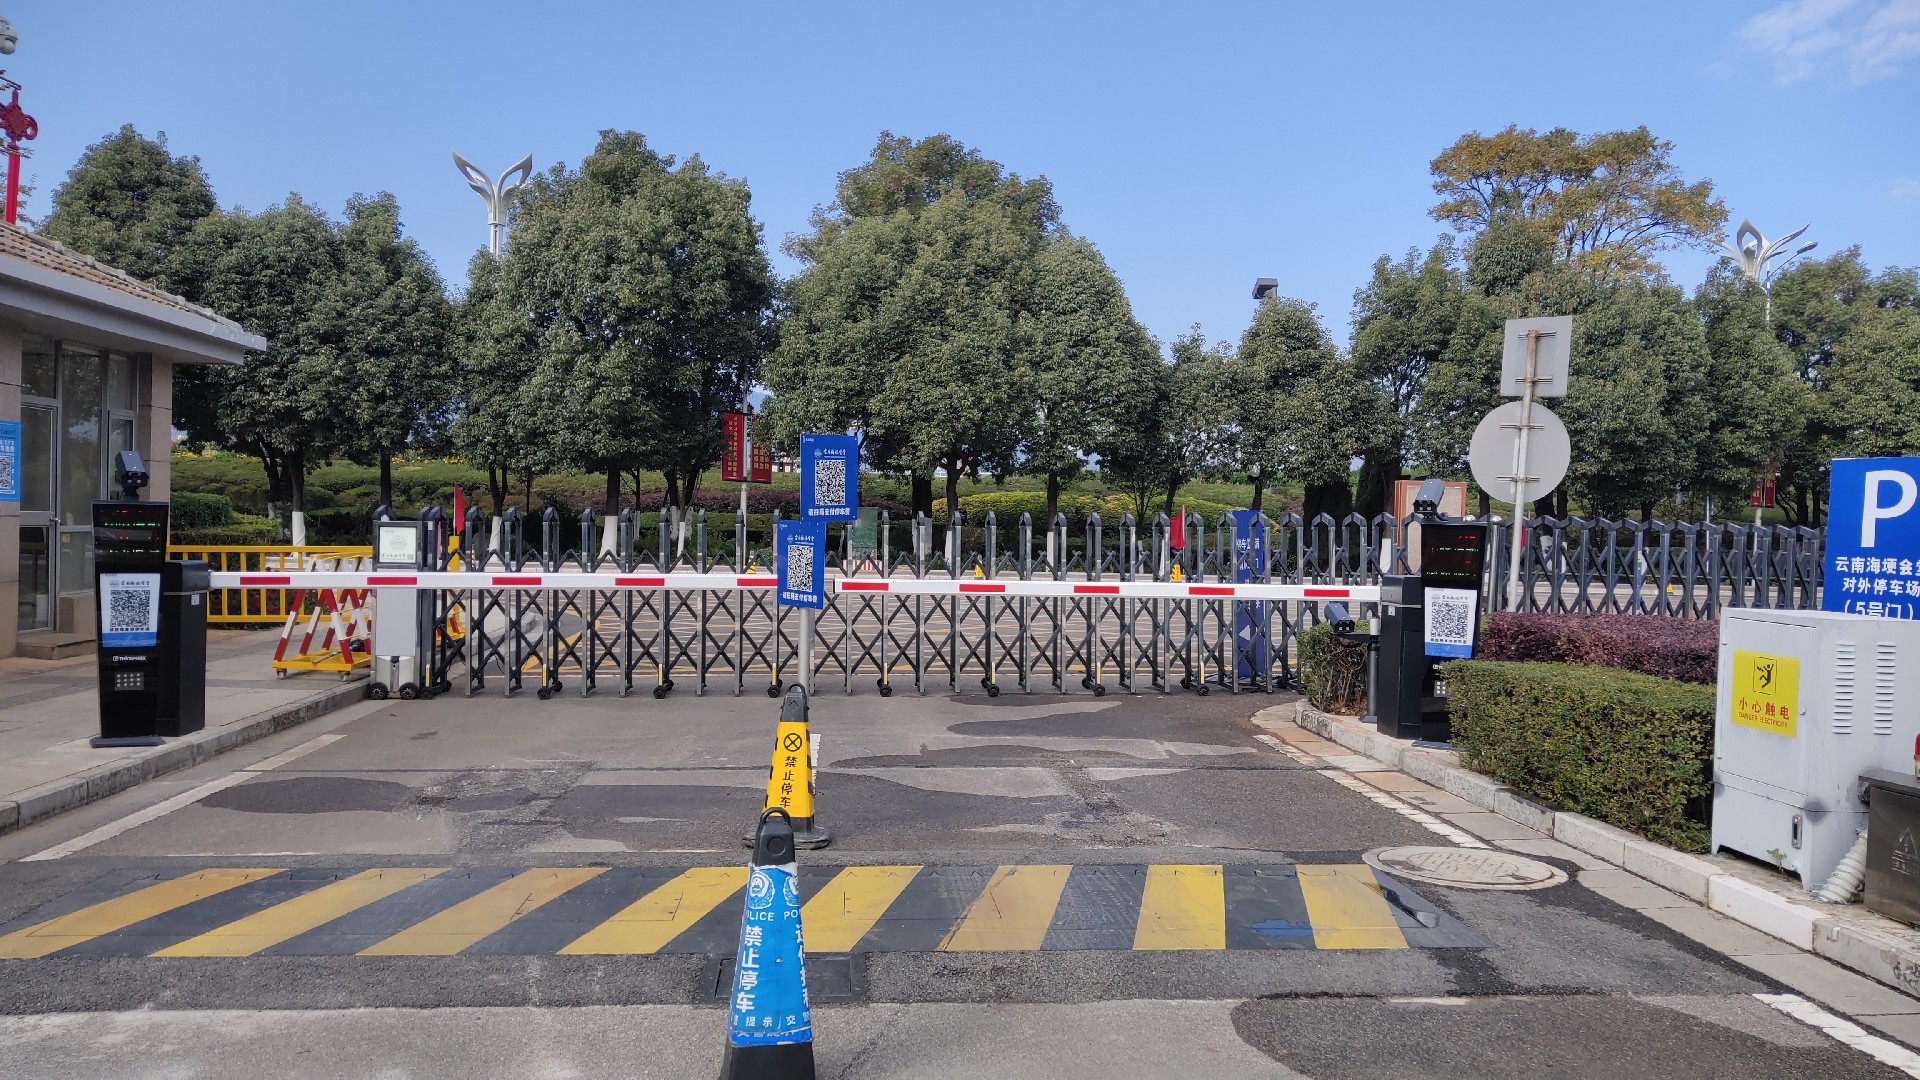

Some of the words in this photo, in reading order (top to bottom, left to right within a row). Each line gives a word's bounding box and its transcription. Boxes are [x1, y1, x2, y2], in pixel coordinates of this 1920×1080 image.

[1861, 470, 1917, 548] P
[1842, 577, 1920, 598] 对外停车场
[1739, 697, 1789, 720] 小心触电
[780, 755, 797, 809] 禁止停车
[736, 924, 762, 1013] 禁止停车
